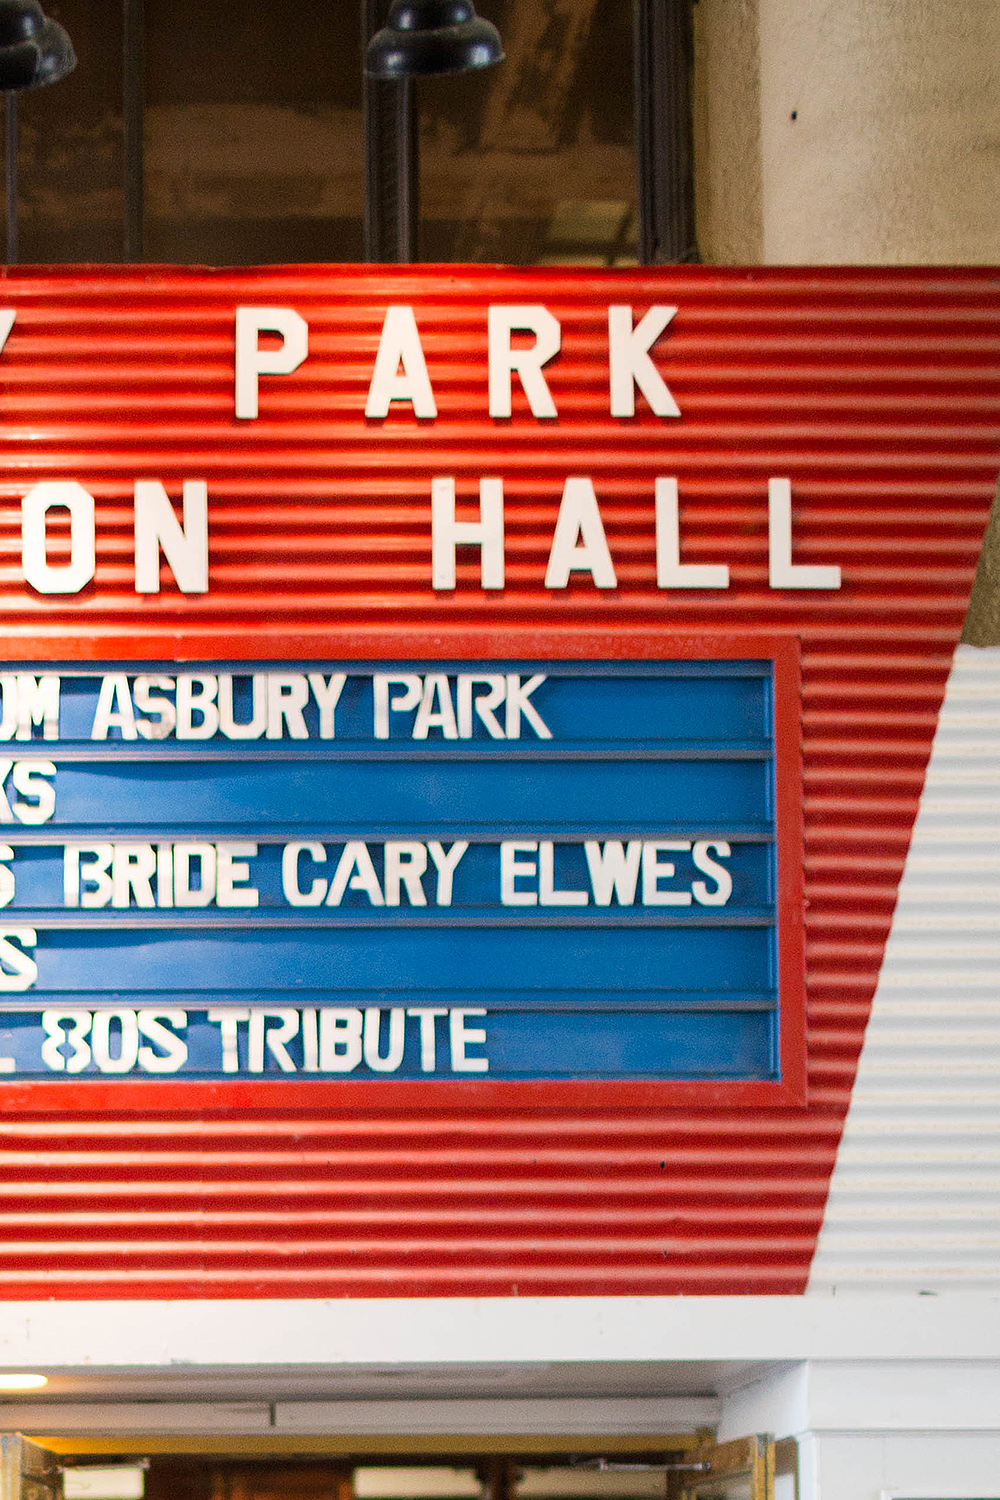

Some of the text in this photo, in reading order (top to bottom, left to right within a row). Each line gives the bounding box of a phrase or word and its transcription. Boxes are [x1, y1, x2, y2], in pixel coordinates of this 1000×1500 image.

[236, 306, 680, 418] PARK
[432, 478, 840, 589] HALL
[91, 673, 346, 739] ASBURY
[374, 673, 552, 738] PARK
[63, 842, 258, 907] BRIDE
[283, 841, 468, 906] CARY
[501, 840, 732, 905] ELWES
[41, 1008, 187, 1073] 80S
[207, 1008, 488, 1072] TRIBUTE
